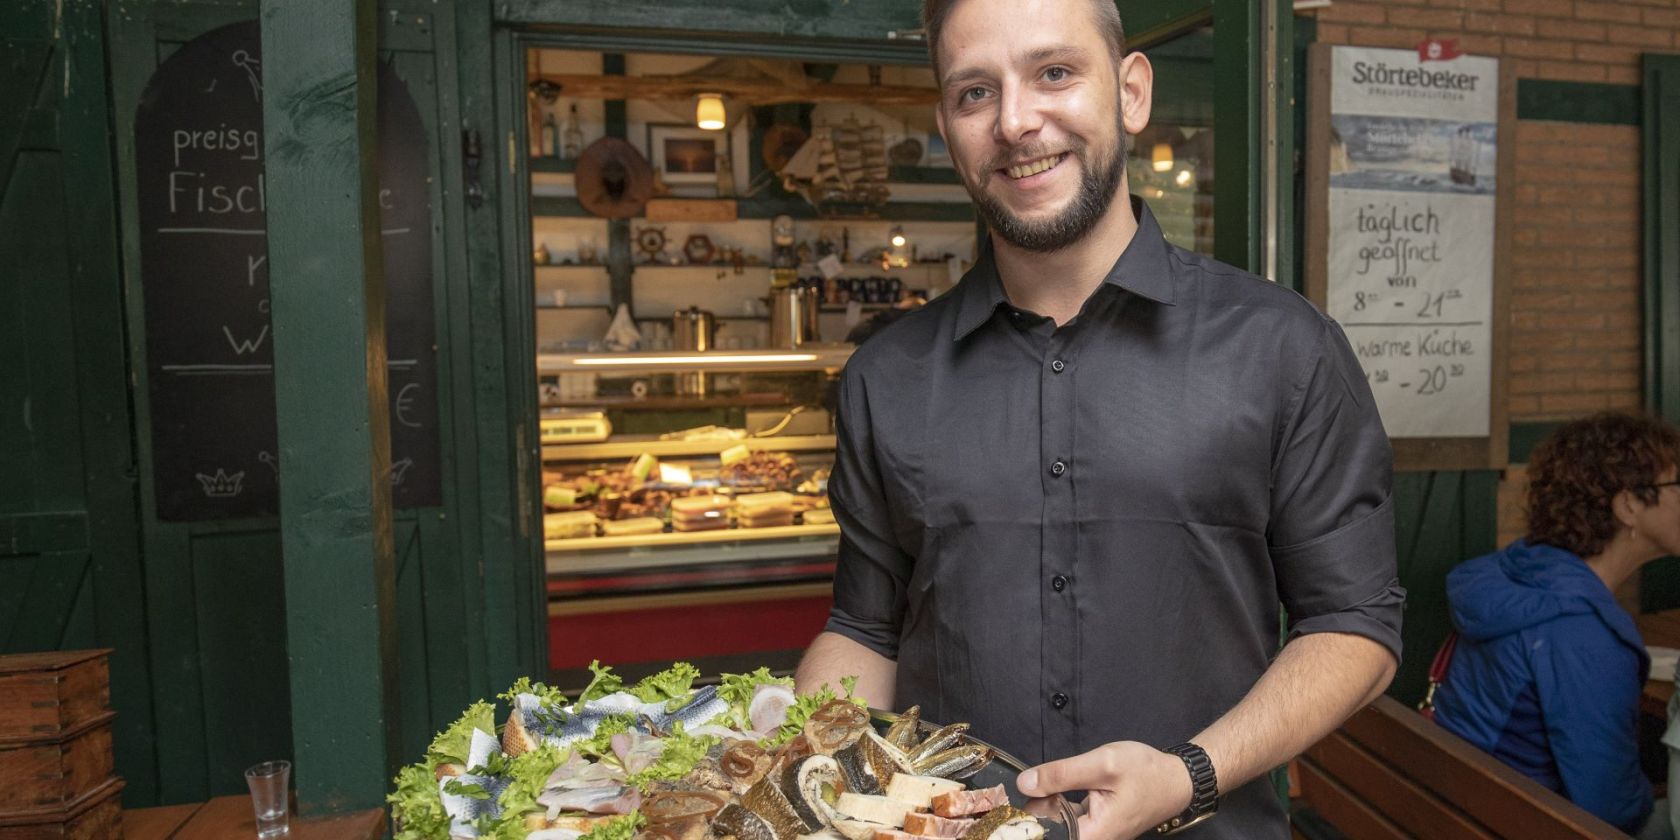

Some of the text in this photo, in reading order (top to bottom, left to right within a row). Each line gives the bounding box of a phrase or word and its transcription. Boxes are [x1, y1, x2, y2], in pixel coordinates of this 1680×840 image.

[1352, 60, 1479, 91] Störtebeker
[173, 122, 259, 168] preisg
[1358, 203, 1440, 244] täglich
[1387, 275, 1417, 287] von
[1357, 329, 1475, 357] warme Küche
